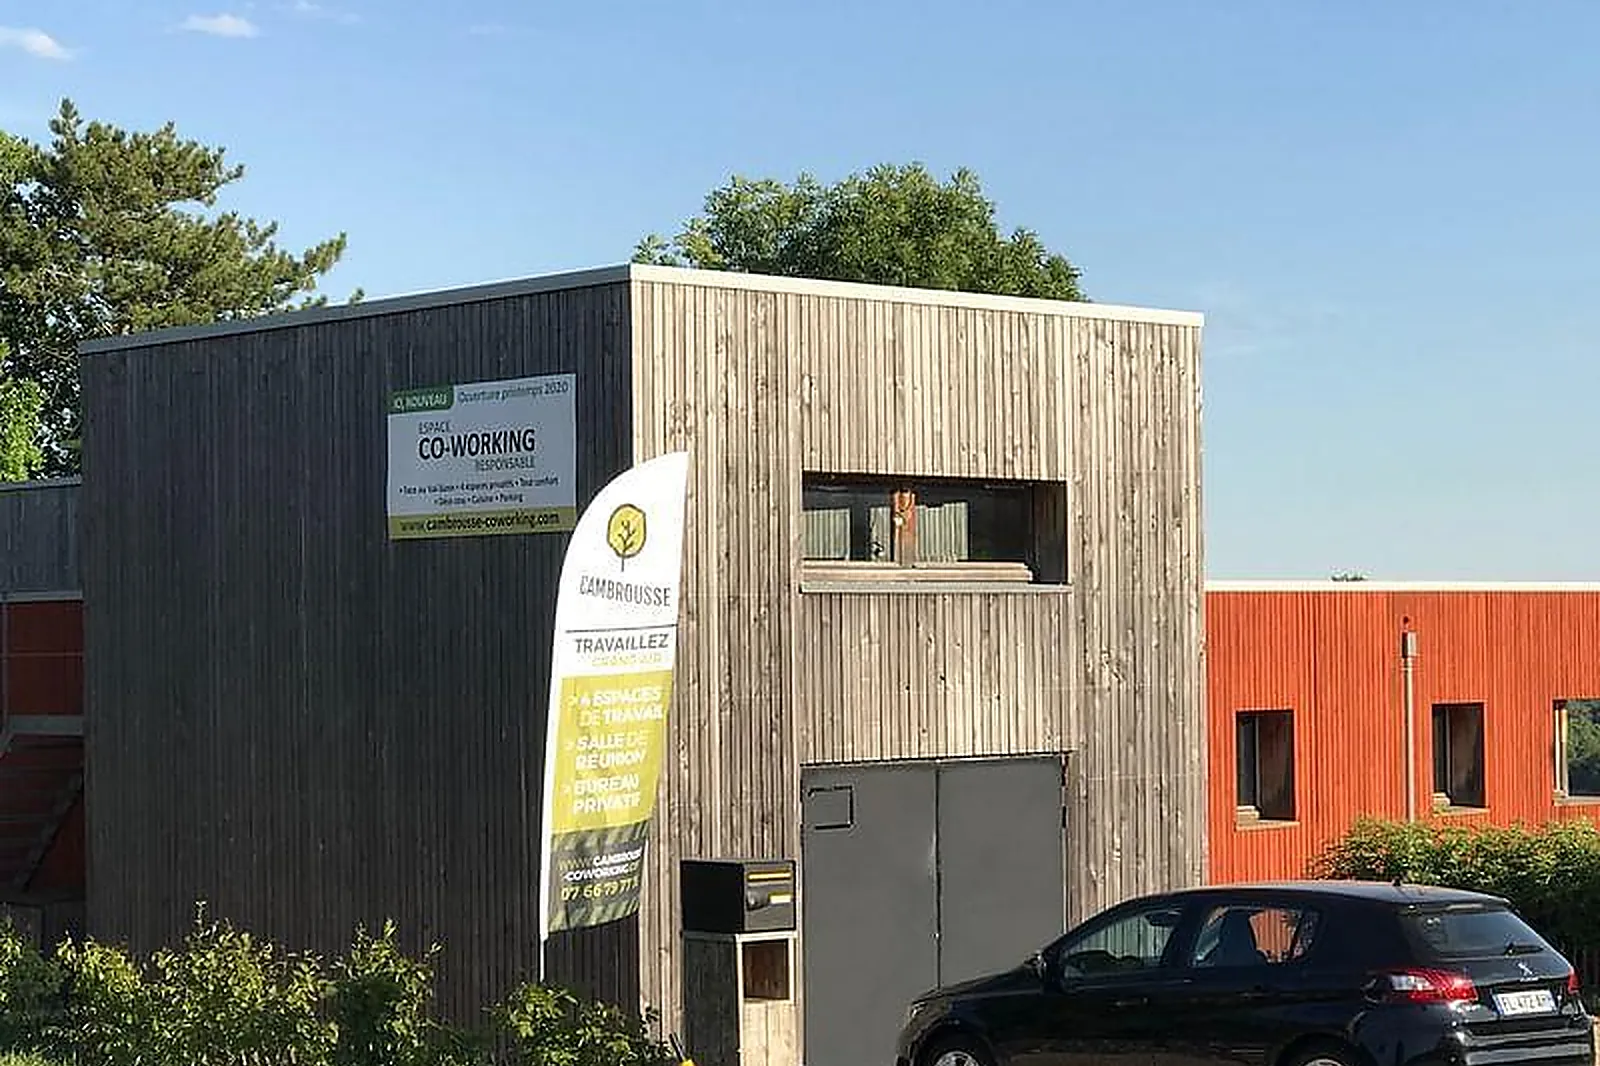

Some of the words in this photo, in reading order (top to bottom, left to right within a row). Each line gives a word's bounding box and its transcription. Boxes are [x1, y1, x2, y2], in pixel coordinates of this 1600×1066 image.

[544, 381, 569, 395] 2020
[418, 421, 450, 435] ESPACE
[418, 428, 536, 460] CO-WORKING
[477, 455, 535, 471] RESPONSABLE
[580, 575, 671, 607] CAMBROUSSE
[574, 633, 670, 653] TRAVAILLEZ
[579, 710, 600, 728] DE
[576, 732, 625, 751] SALLE
[626, 730, 648, 748] DE
[574, 774, 640, 796] BUREAU
[561, 885, 580, 901] 07
[583, 883, 601, 898] 66
